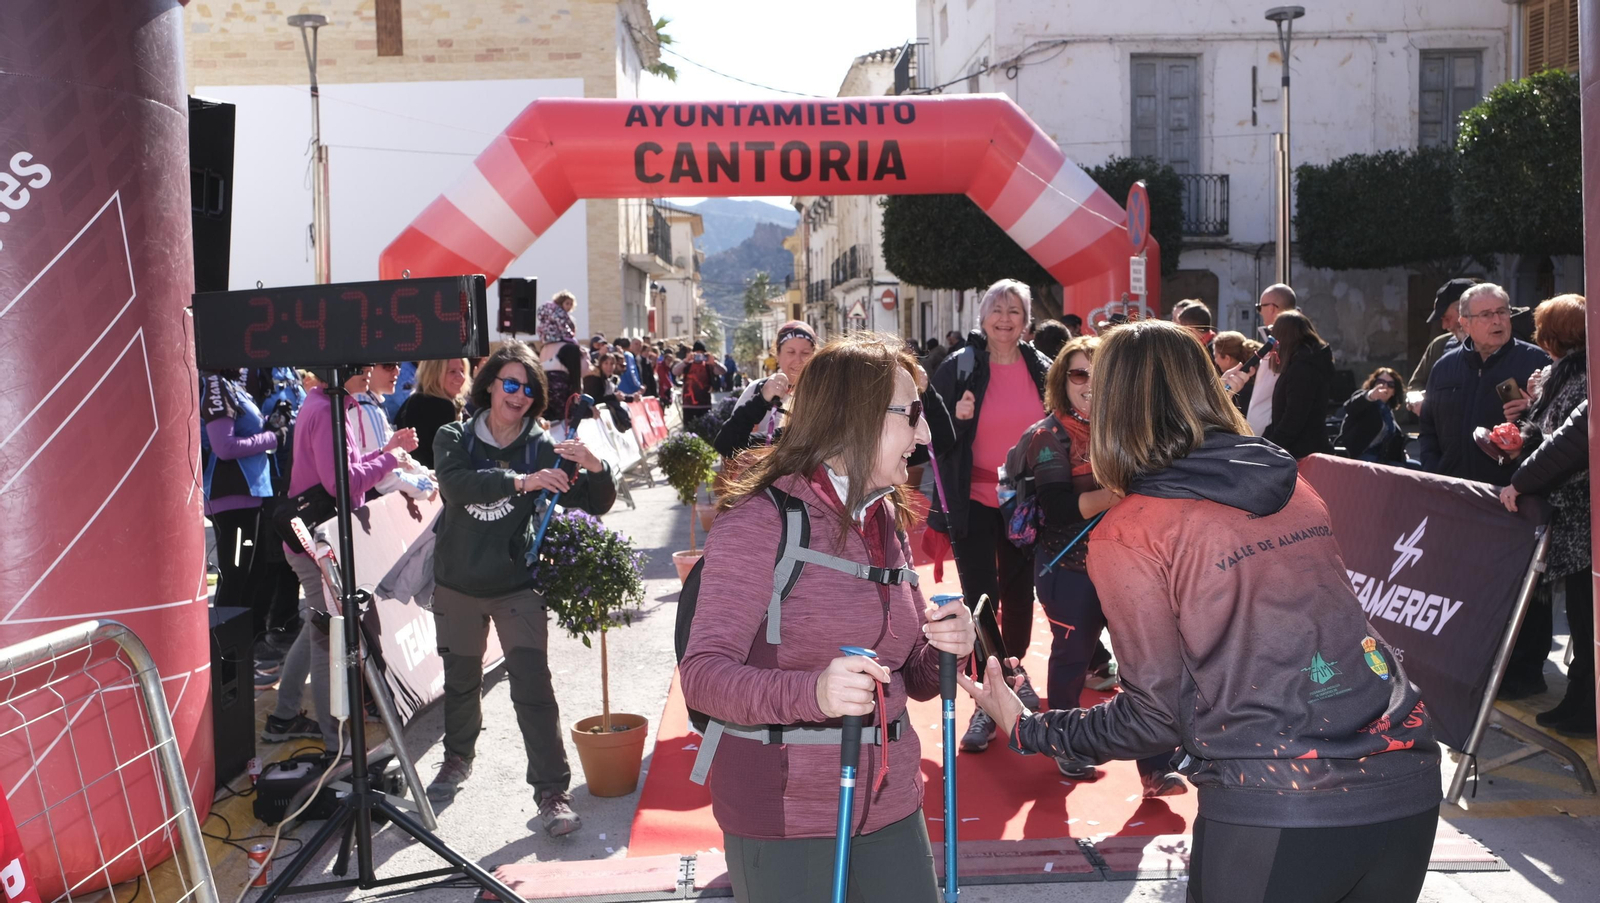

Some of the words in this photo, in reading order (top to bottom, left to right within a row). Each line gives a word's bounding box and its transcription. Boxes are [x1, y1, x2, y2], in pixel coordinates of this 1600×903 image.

[625, 101, 916, 127] AYUNTAMIENTO
[634, 140, 907, 184] CANTORIA
[464, 503, 515, 522] NTABRIA
[1215, 544, 1256, 572] VALLE
[1257, 539, 1275, 552] DE
